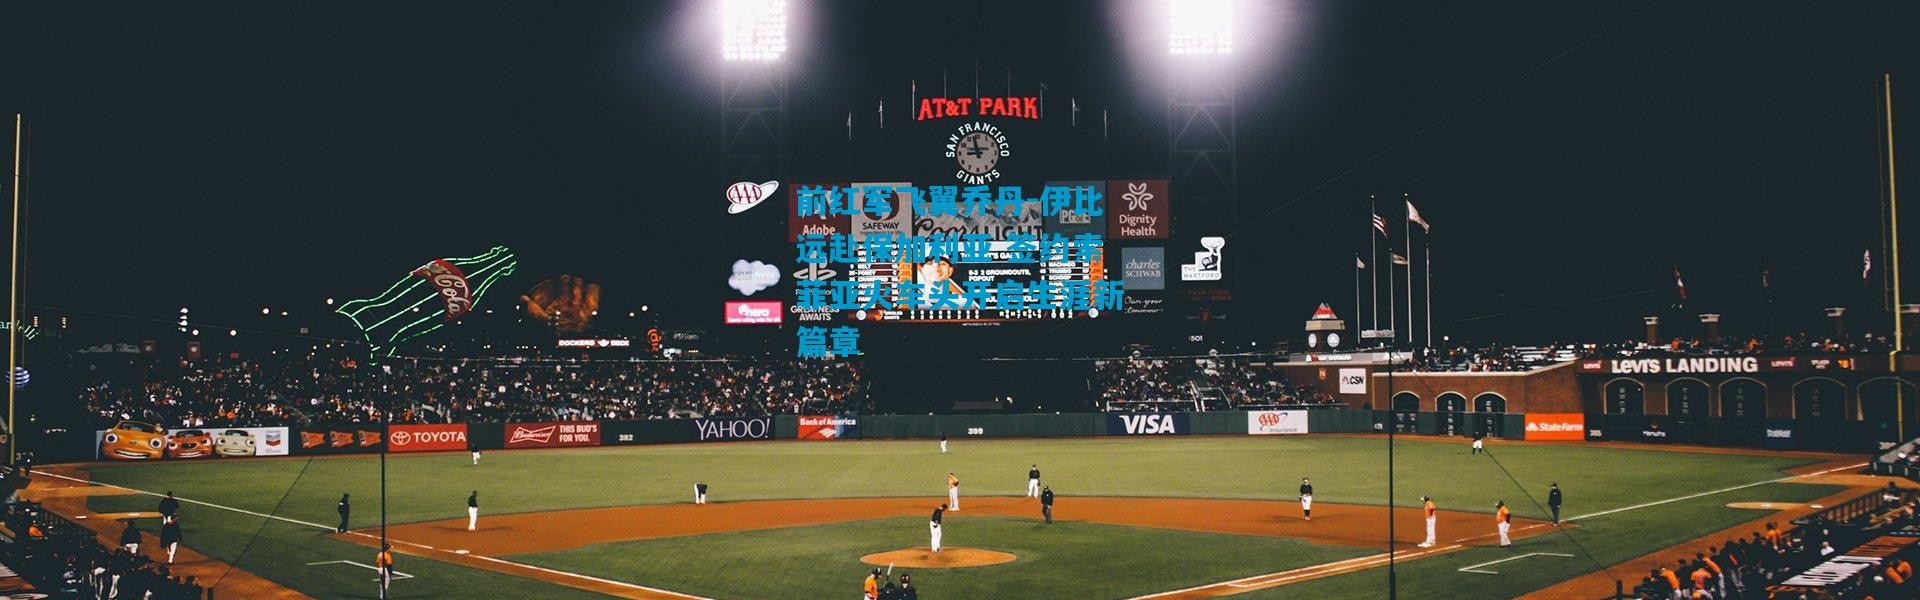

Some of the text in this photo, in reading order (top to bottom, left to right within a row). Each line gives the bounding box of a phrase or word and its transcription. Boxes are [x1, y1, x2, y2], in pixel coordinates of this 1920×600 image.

[917, 96, 1038, 121] AT&T PARK
[946, 121, 1010, 158] SAN FRANCISCO
[956, 169, 1001, 185] GIANTS
[862, 222, 899, 230] SAFEWAY
[1119, 214, 1157, 227] Dignity
[802, 224, 835, 236] Adobe
[1121, 227, 1156, 236] Health
[1126, 259, 1160, 270] charles
[734, 270, 775, 282] salesforce
[1125, 270, 1161, 278] SCHWAB
[799, 313, 831, 321] AWAITS
[1666, 357, 1758, 373] LANDING
[1350, 376, 1364, 385] CSN
[800, 418, 856, 426] Bank of America
[1119, 415, 1175, 434] VISA
[559, 424, 597, 433] THIS BUD'S
[696, 418, 771, 441] YAHOO!
[413, 431, 467, 443] TOYOTA
[559, 433, 591, 442] FOR YOU.
